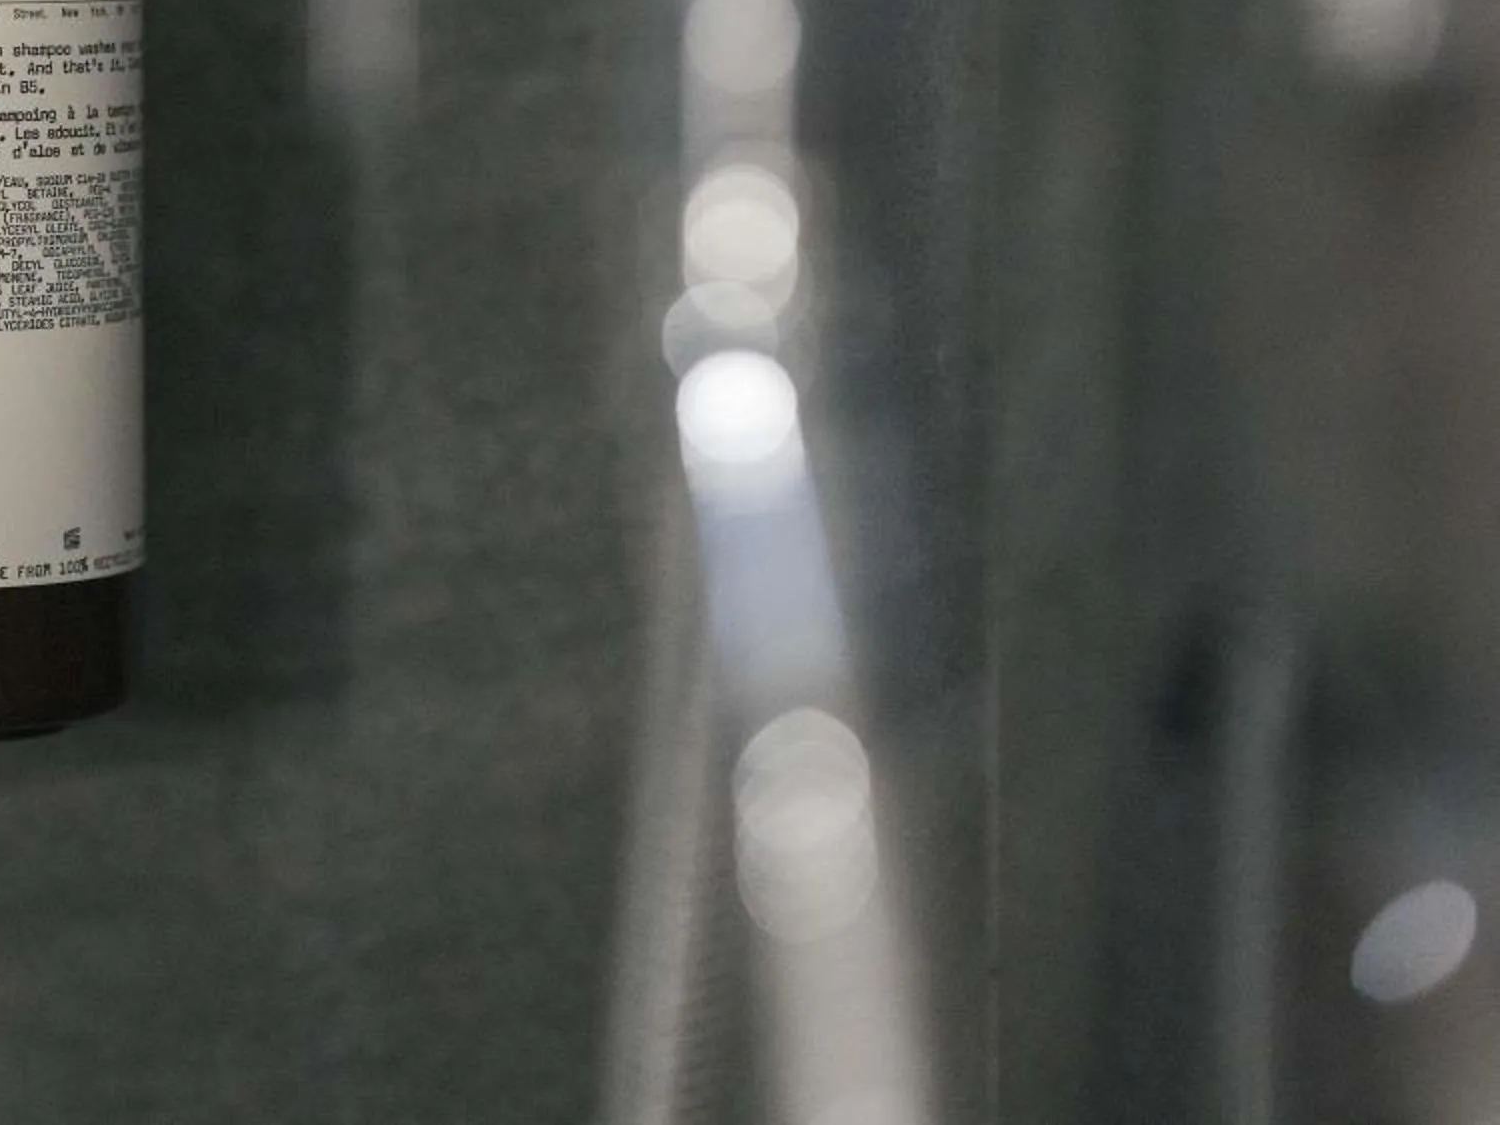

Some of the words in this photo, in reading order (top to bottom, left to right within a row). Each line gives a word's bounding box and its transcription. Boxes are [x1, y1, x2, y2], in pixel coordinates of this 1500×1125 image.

[13, 42, 72, 59] shampoo
[27, 61, 53, 75] And
[17, 563, 53, 579] FROM
